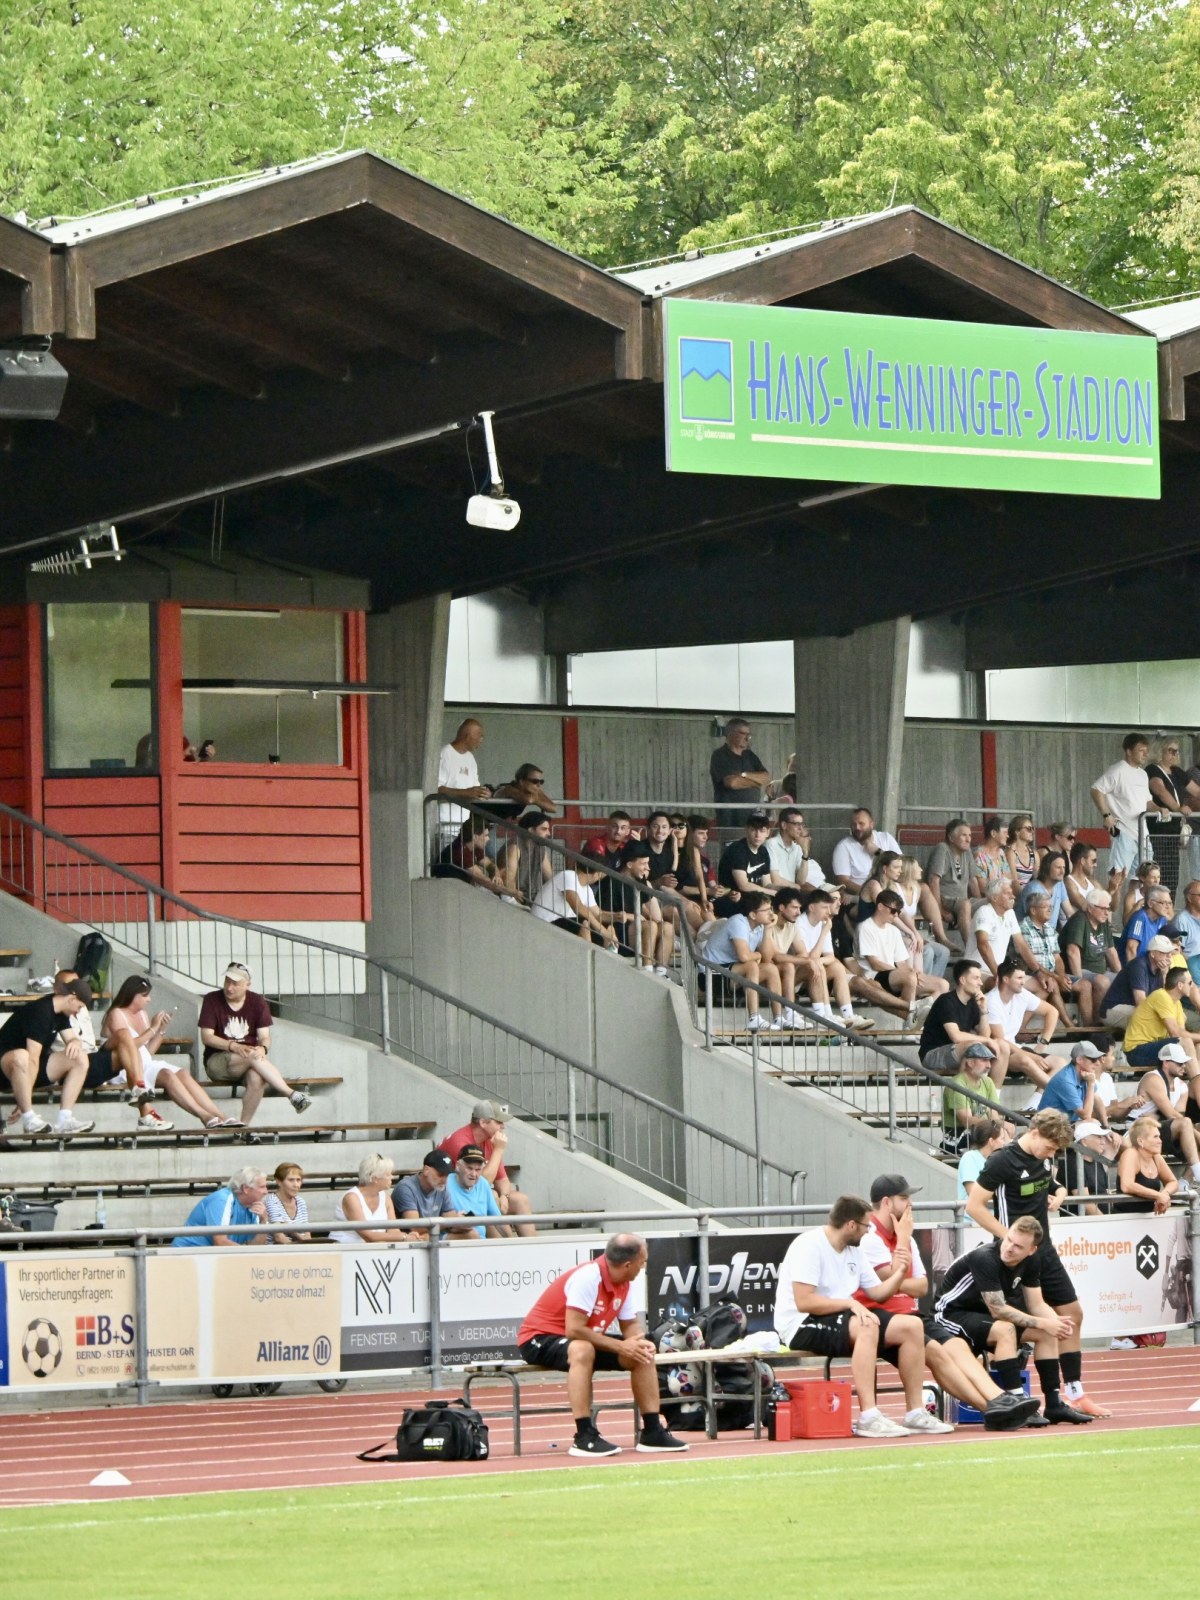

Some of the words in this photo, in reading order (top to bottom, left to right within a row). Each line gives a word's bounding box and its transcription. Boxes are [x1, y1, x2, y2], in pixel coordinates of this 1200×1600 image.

[1053, 1237, 1132, 1260] stleitungen
[19, 1269, 31, 1282] Ihr
[33, 1267, 80, 1285] sportlicher
[82, 1267, 114, 1281] Partner
[117, 1266, 126, 1279] in
[251, 1267, 265, 1280] Ne
[267, 1267, 285, 1280] olur
[287, 1268, 300, 1279] ne
[457, 1269, 541, 1291] montagen
[19, 1286, 114, 1303] Versicherungsfragen:
[296, 1285, 326, 1298] olmaz!
[97, 1314, 135, 1345] B+S
[351, 1332, 397, 1347] FENSTER
[410, 1330, 446, 1344] TÜRN
[76, 1351, 101, 1360] BERND
[107, 1350, 135, 1359] STEFAN
[147, 1348, 177, 1357] HUSTER
[256, 1341, 310, 1362] Allianz
